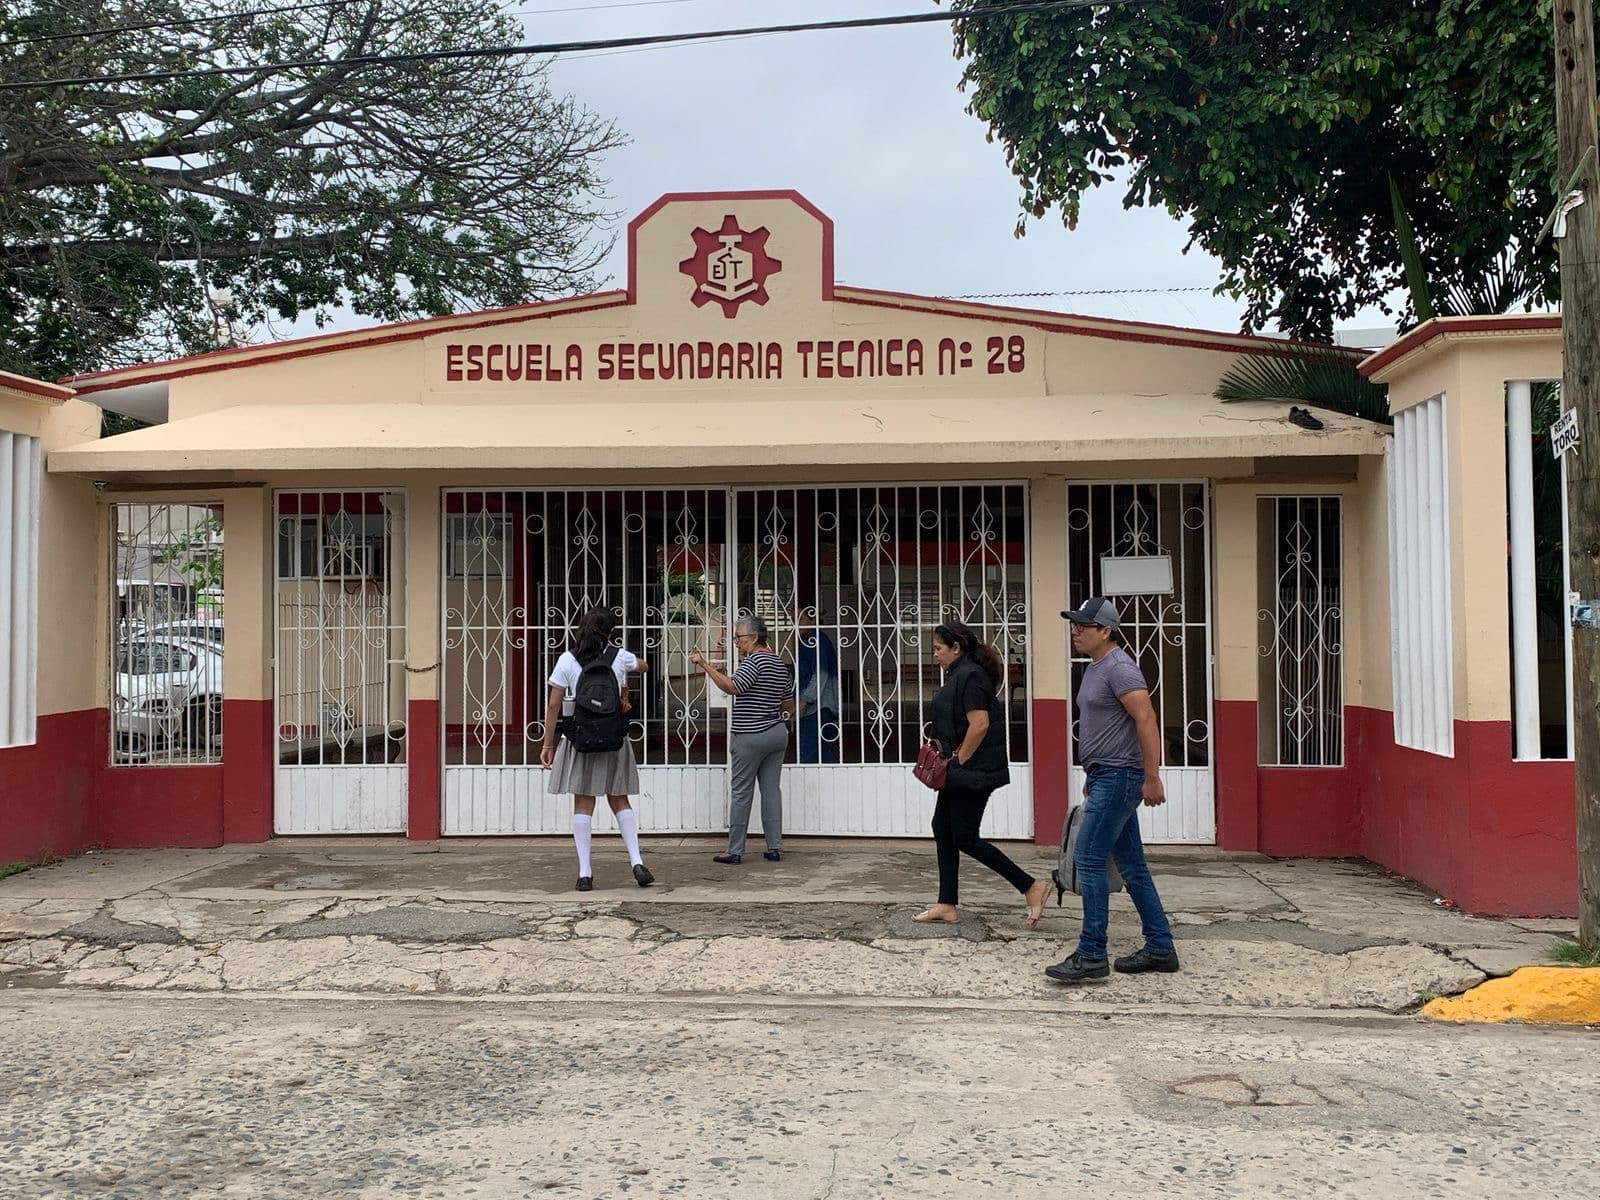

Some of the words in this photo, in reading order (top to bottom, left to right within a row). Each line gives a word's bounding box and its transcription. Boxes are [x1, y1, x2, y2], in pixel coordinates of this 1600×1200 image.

[446, 344, 583, 381] ESCUELA
[598, 341, 782, 381] SECUNDARIA
[796, 339, 924, 378] TECNICA
[987, 335, 1025, 375] 28
[1553, 412, 1573, 435] RENTA
[1553, 424, 1576, 454] TORO
